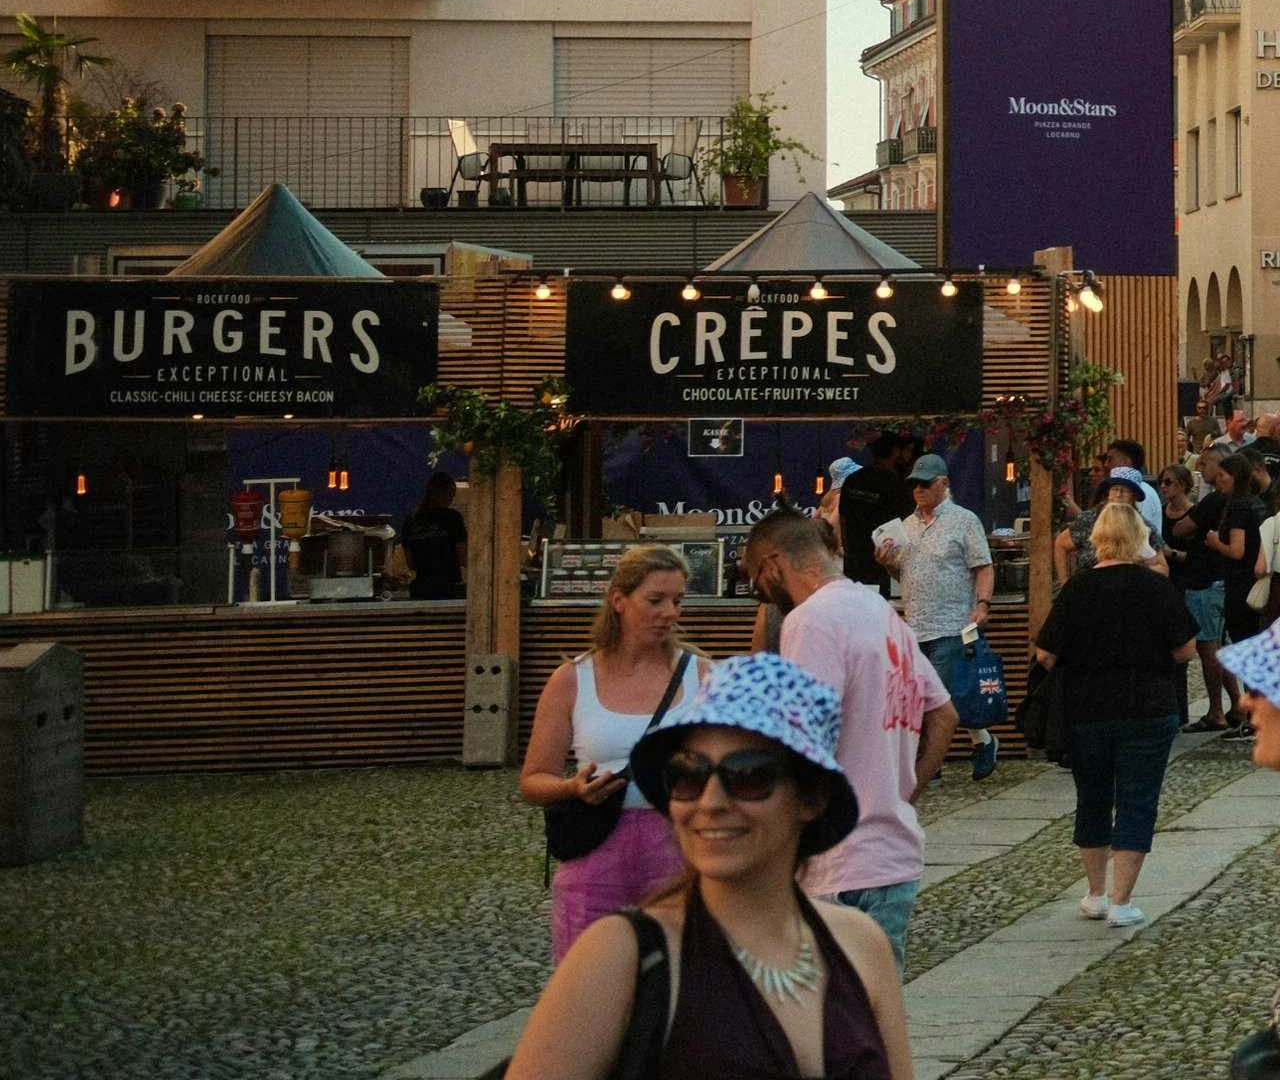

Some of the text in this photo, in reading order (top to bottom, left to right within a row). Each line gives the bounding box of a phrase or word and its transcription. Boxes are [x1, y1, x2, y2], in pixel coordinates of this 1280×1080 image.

[1008, 97, 1117, 116] Moon&Stars
[196, 294, 250, 305] ROCKFOOD
[65, 309, 381, 375] BURGERS
[650, 305, 897, 375] CRÊPES
[157, 366, 288, 382] EXCEPTIONAL
[717, 366, 832, 381] EXCEPTIONAL
[296, 390, 334, 402] BACON
[682, 386, 860, 401] CHOCOLATE-FRUITY-SWEET
